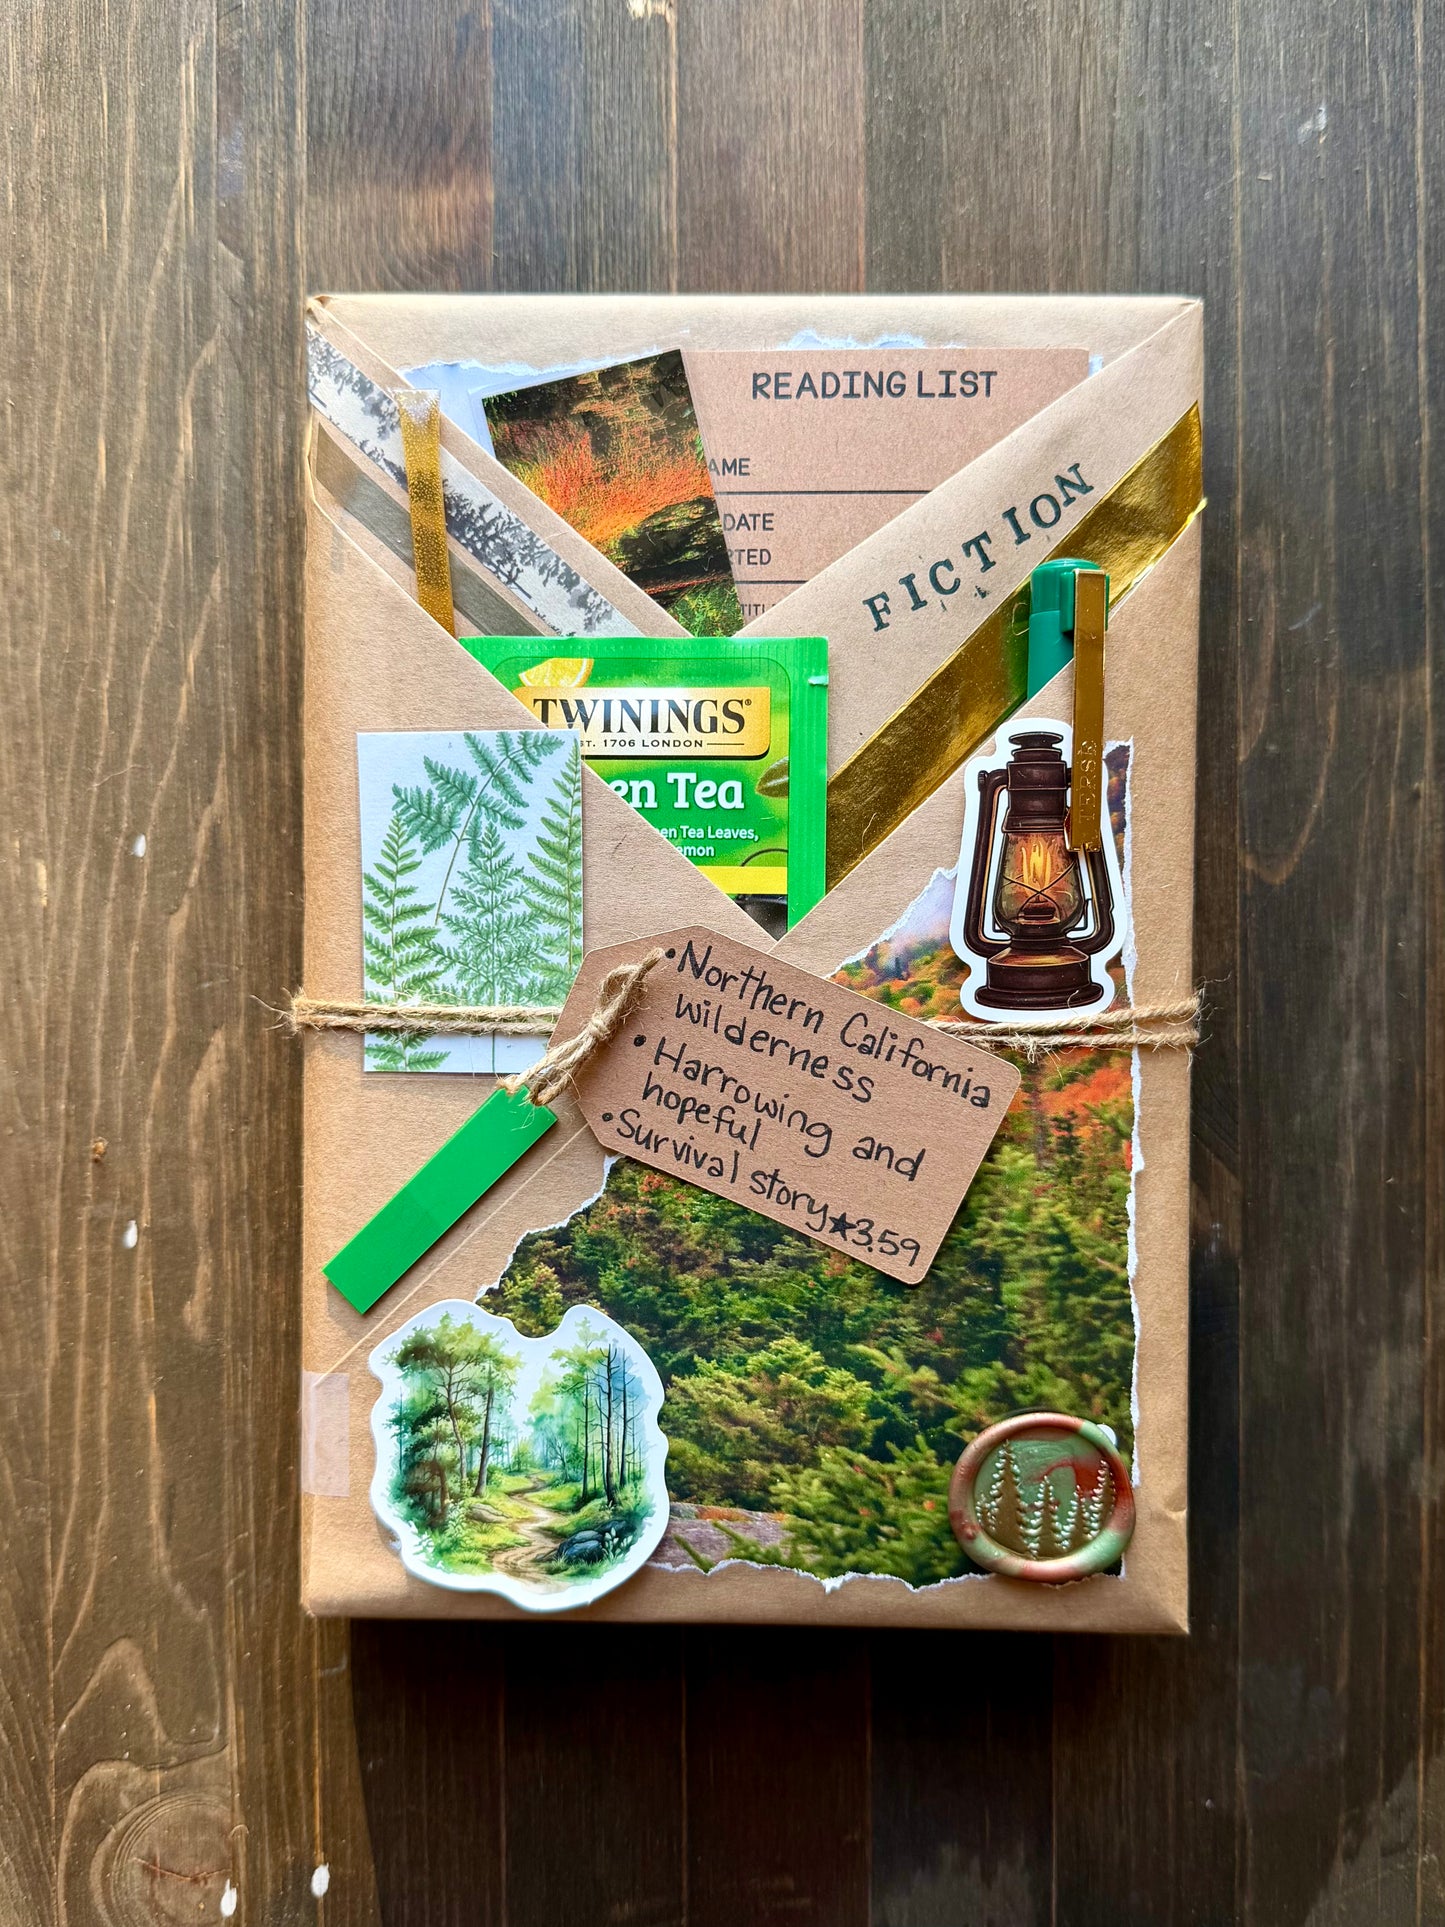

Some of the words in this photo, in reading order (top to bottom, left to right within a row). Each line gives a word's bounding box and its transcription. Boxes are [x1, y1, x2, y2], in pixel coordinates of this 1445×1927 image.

[752, 371, 907, 401] READING
[917, 370, 998, 399] LIST
[722, 512, 775, 532] DATE
[862, 462, 1095, 632] FICTION
[603, 738, 637, 748] 1706
[641, 738, 704, 748] LONDON
[666, 772, 744, 809] Tea
[679, 825, 705, 840] Tea
[707, 825, 760, 842] Leaves,
[676, 940, 824, 1033] Northern
[840, 1012, 991, 1109] California
[642, 1071, 762, 1151] hopeful
[653, 1036, 833, 1158] Harrowing
[852, 1135, 927, 1182] and
[616, 1108, 740, 1184] Survival
[749, 1168, 829, 1233] story
[852, 1218, 921, 1268] 3.59
